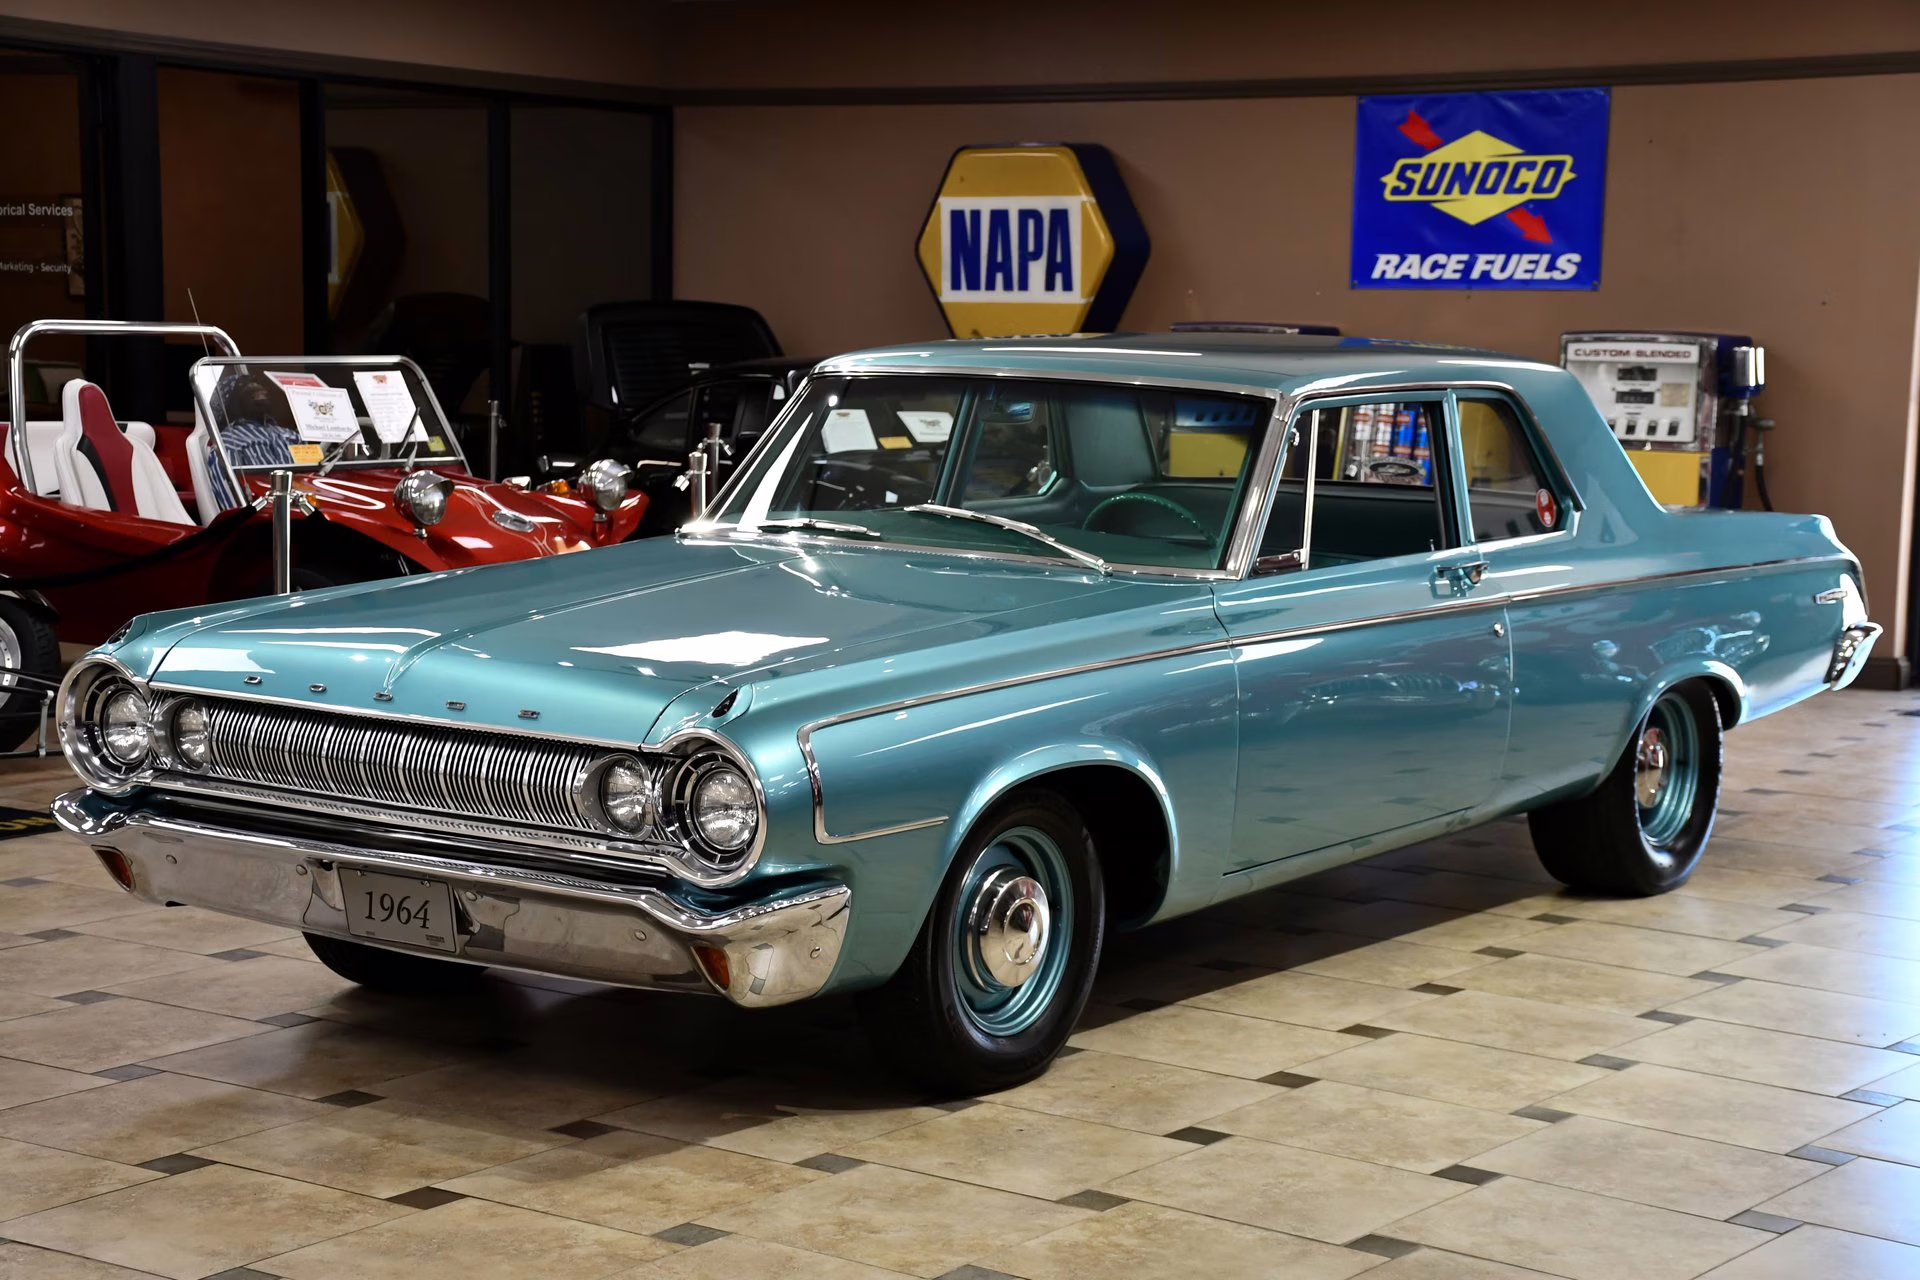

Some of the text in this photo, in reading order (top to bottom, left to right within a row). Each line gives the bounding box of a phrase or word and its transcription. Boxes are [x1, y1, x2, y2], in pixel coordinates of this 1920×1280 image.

[1389, 159, 1568, 196] SUNOCO
[28, 203, 73, 216] Services
[949, 208, 1074, 292] NAPA
[40, 262, 72, 274] Security
[1370, 252, 1582, 281] RACE FUELS
[1574, 348, 1692, 359] CUSTOM BLENDED
[364, 891, 431, 930] 1964
